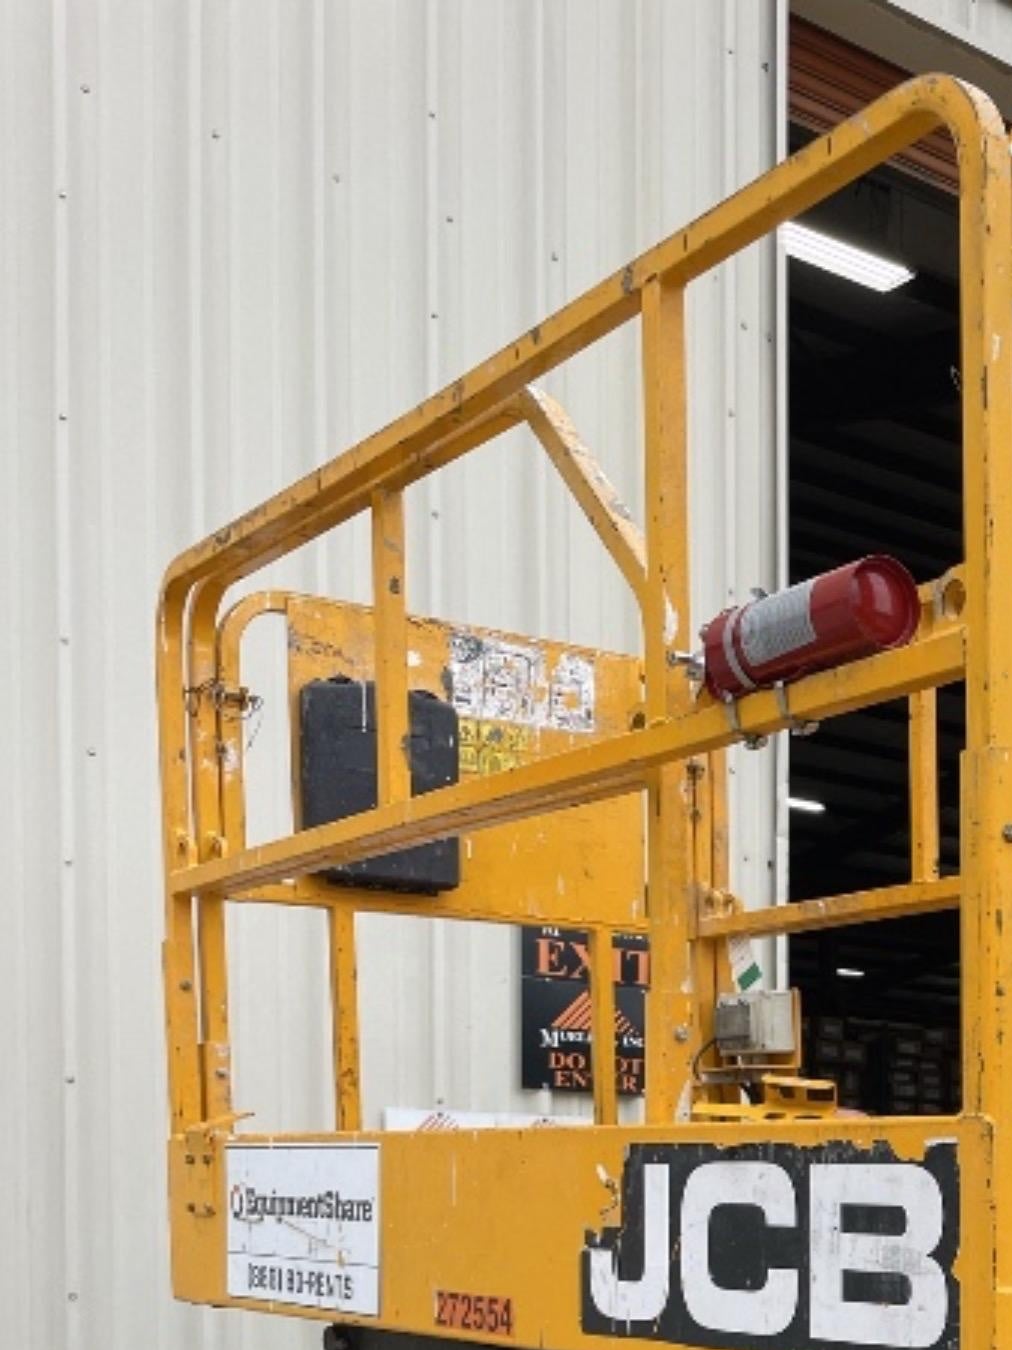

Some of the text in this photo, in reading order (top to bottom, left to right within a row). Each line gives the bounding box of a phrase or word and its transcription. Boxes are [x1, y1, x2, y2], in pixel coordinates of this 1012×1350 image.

[549, 1051, 587, 1070] DO
[554, 1070, 637, 1092] ENR
[590, 1159, 949, 1350] JCB
[436, 1291, 512, 1336] 272554
